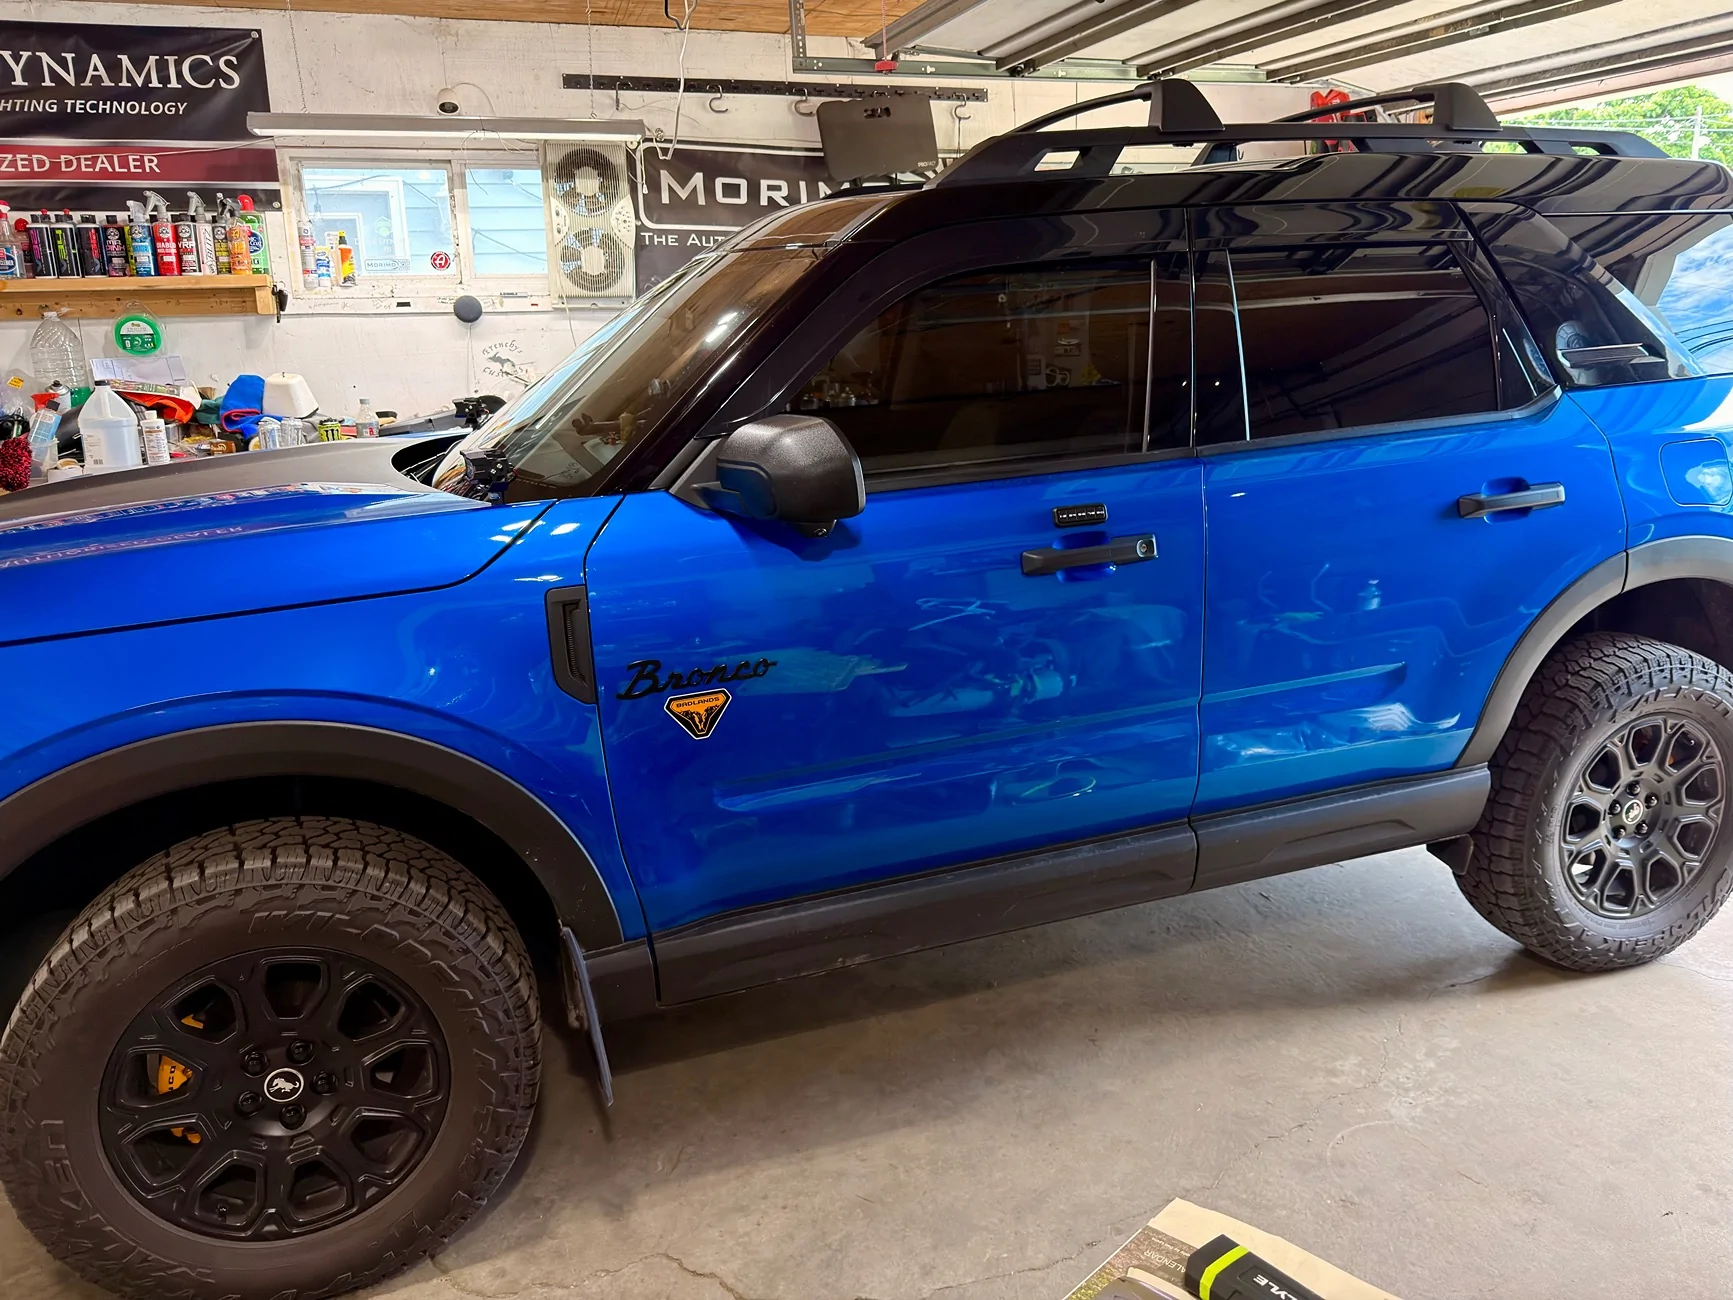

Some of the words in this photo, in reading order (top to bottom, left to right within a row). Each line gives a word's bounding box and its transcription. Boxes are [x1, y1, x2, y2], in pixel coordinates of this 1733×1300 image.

[0, 50, 241, 90] YNAMICS
[0, 99, 58, 113] HTING
[64, 99, 188, 115] TECHNOLOGY
[0, 153, 51, 172] ZED
[60, 153, 161, 173] DEALER
[640, 232, 679, 246] THE
[616, 657, 778, 699] Bronco
[676, 696, 720, 708] BADLANDS
